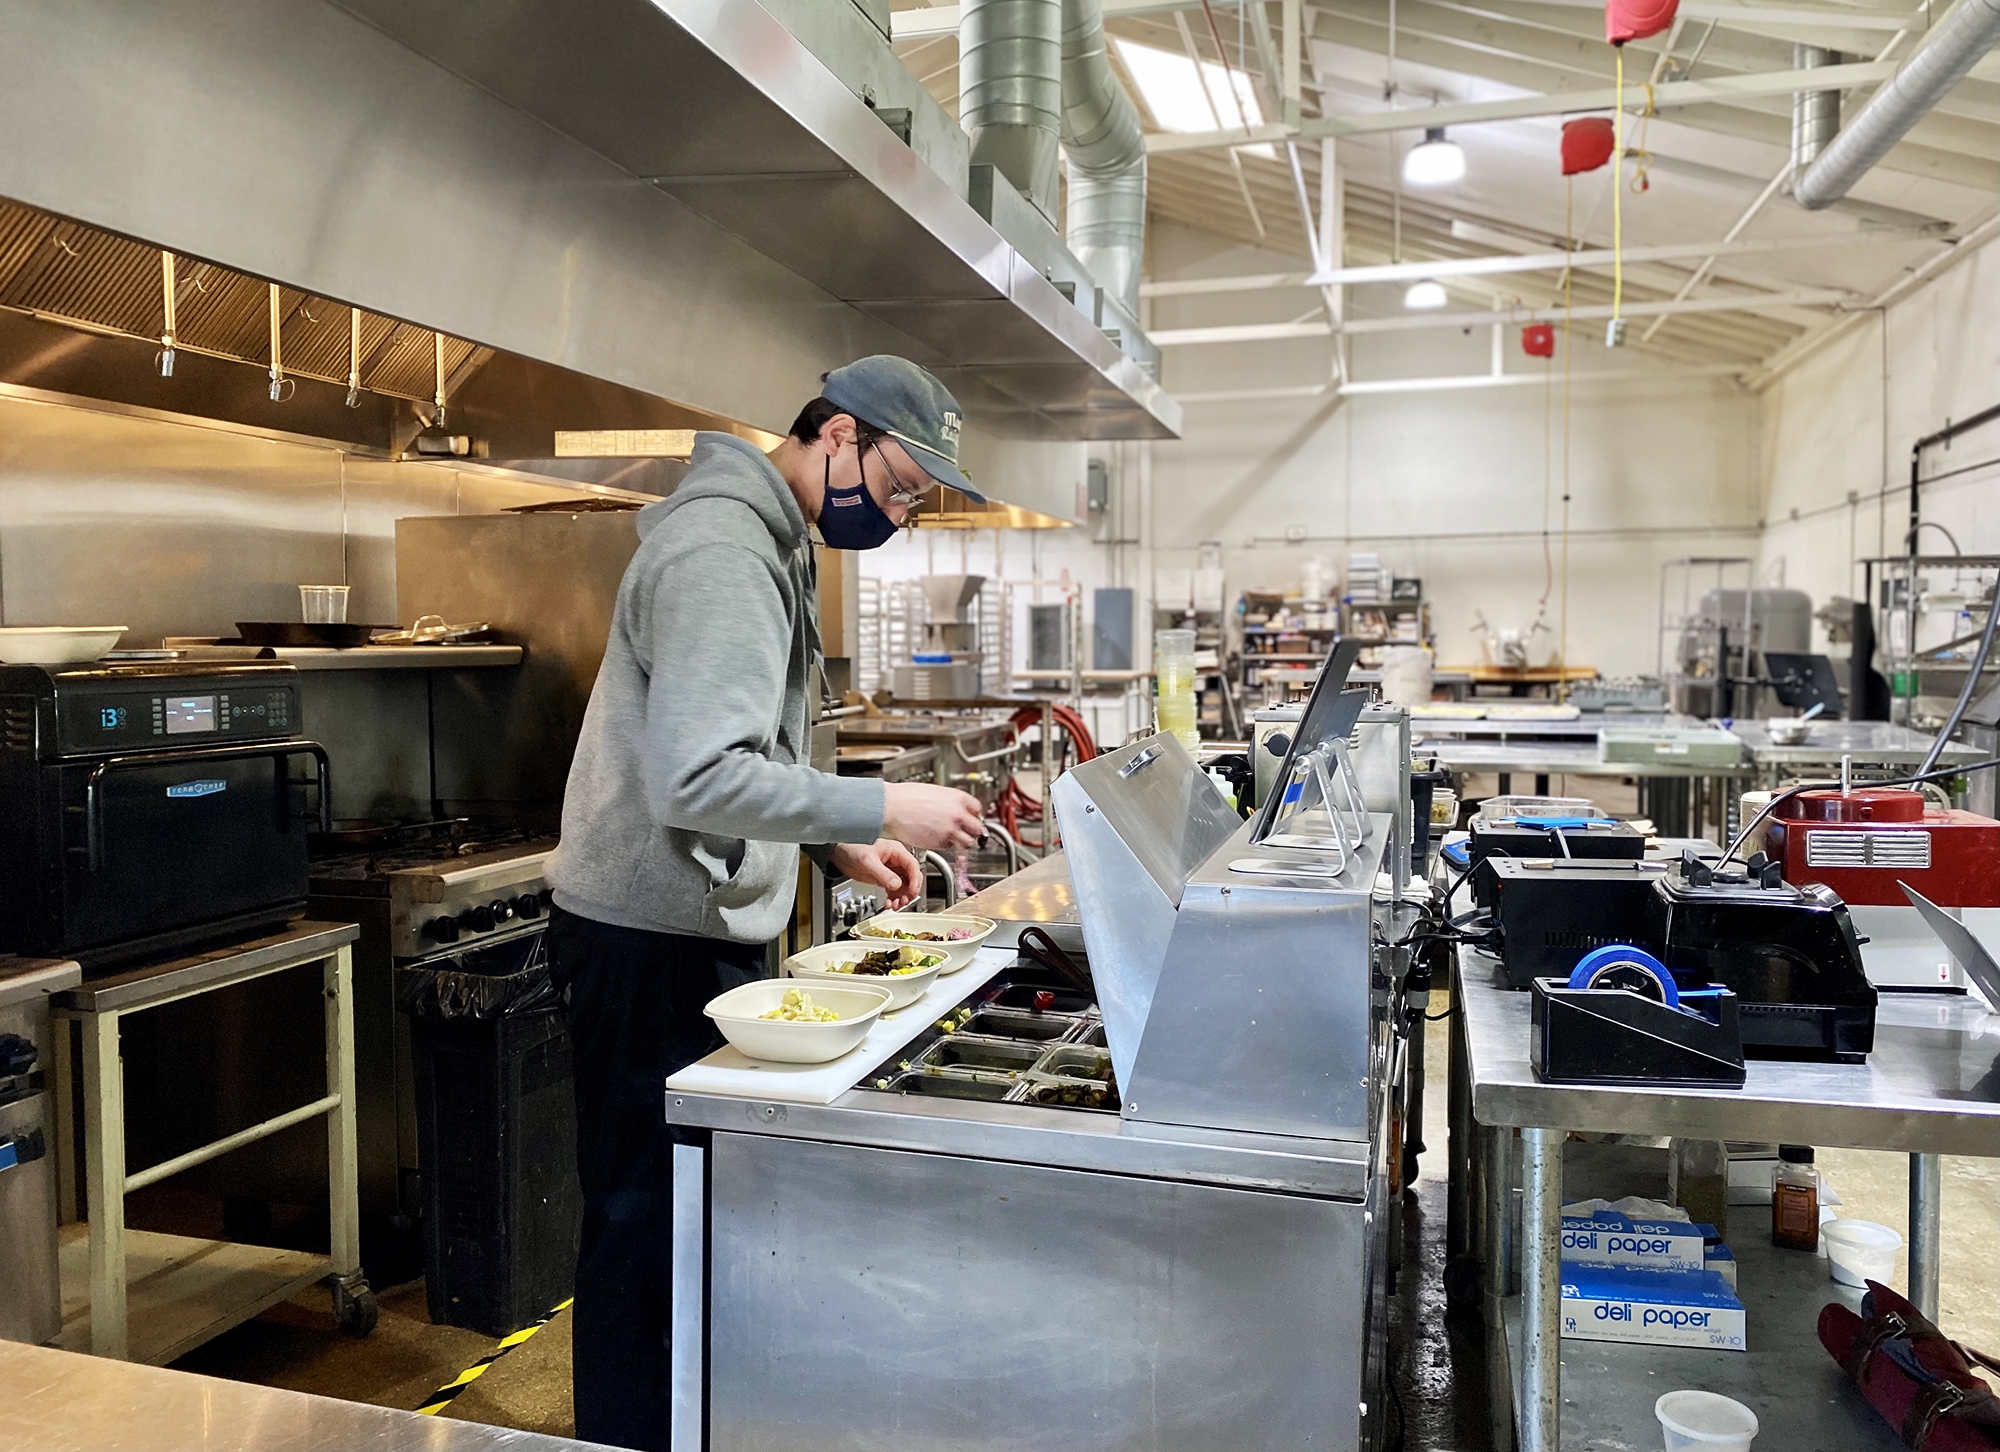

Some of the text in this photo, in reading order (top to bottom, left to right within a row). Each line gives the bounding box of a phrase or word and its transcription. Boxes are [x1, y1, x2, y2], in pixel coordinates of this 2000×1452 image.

[101, 708, 117, 728] i3
[1633, 1224, 1670, 1235] deli
[1562, 1232, 1672, 1256] deli paper
[1670, 1260, 1700, 1269] SW-10
[1594, 1302, 1711, 1329] deli paper
[1710, 1335, 1742, 1346] SW-10
